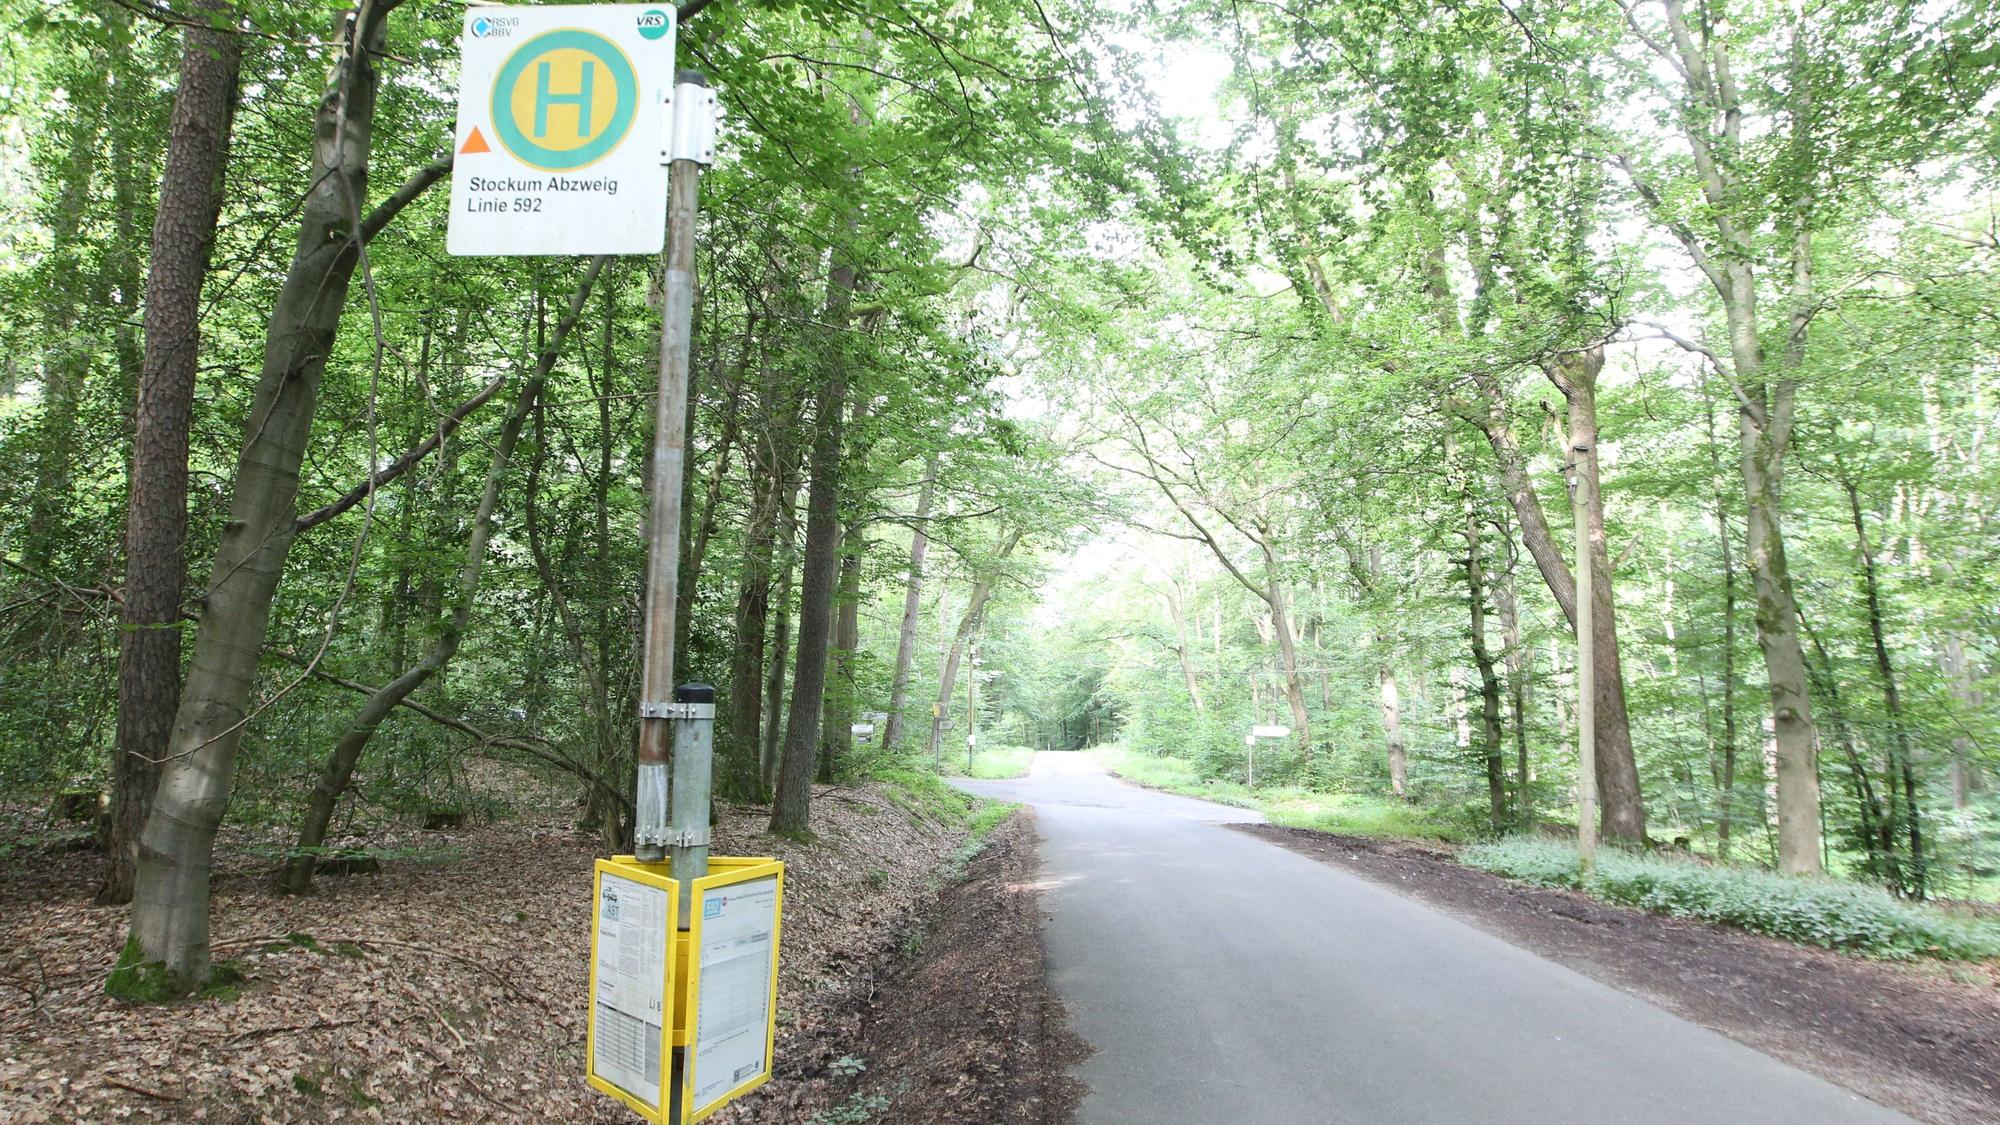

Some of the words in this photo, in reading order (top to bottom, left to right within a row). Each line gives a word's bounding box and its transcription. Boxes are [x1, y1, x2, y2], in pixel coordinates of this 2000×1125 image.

[492, 17, 519, 26] RSVG
[637, 16, 662, 26] VRS
[491, 28, 512, 37] BBV
[533, 61, 594, 138] H
[469, 177, 542, 192] Stockum
[546, 177, 618, 195] Abzweig
[467, 198, 507, 213] Linie
[513, 198, 542, 213] 592
